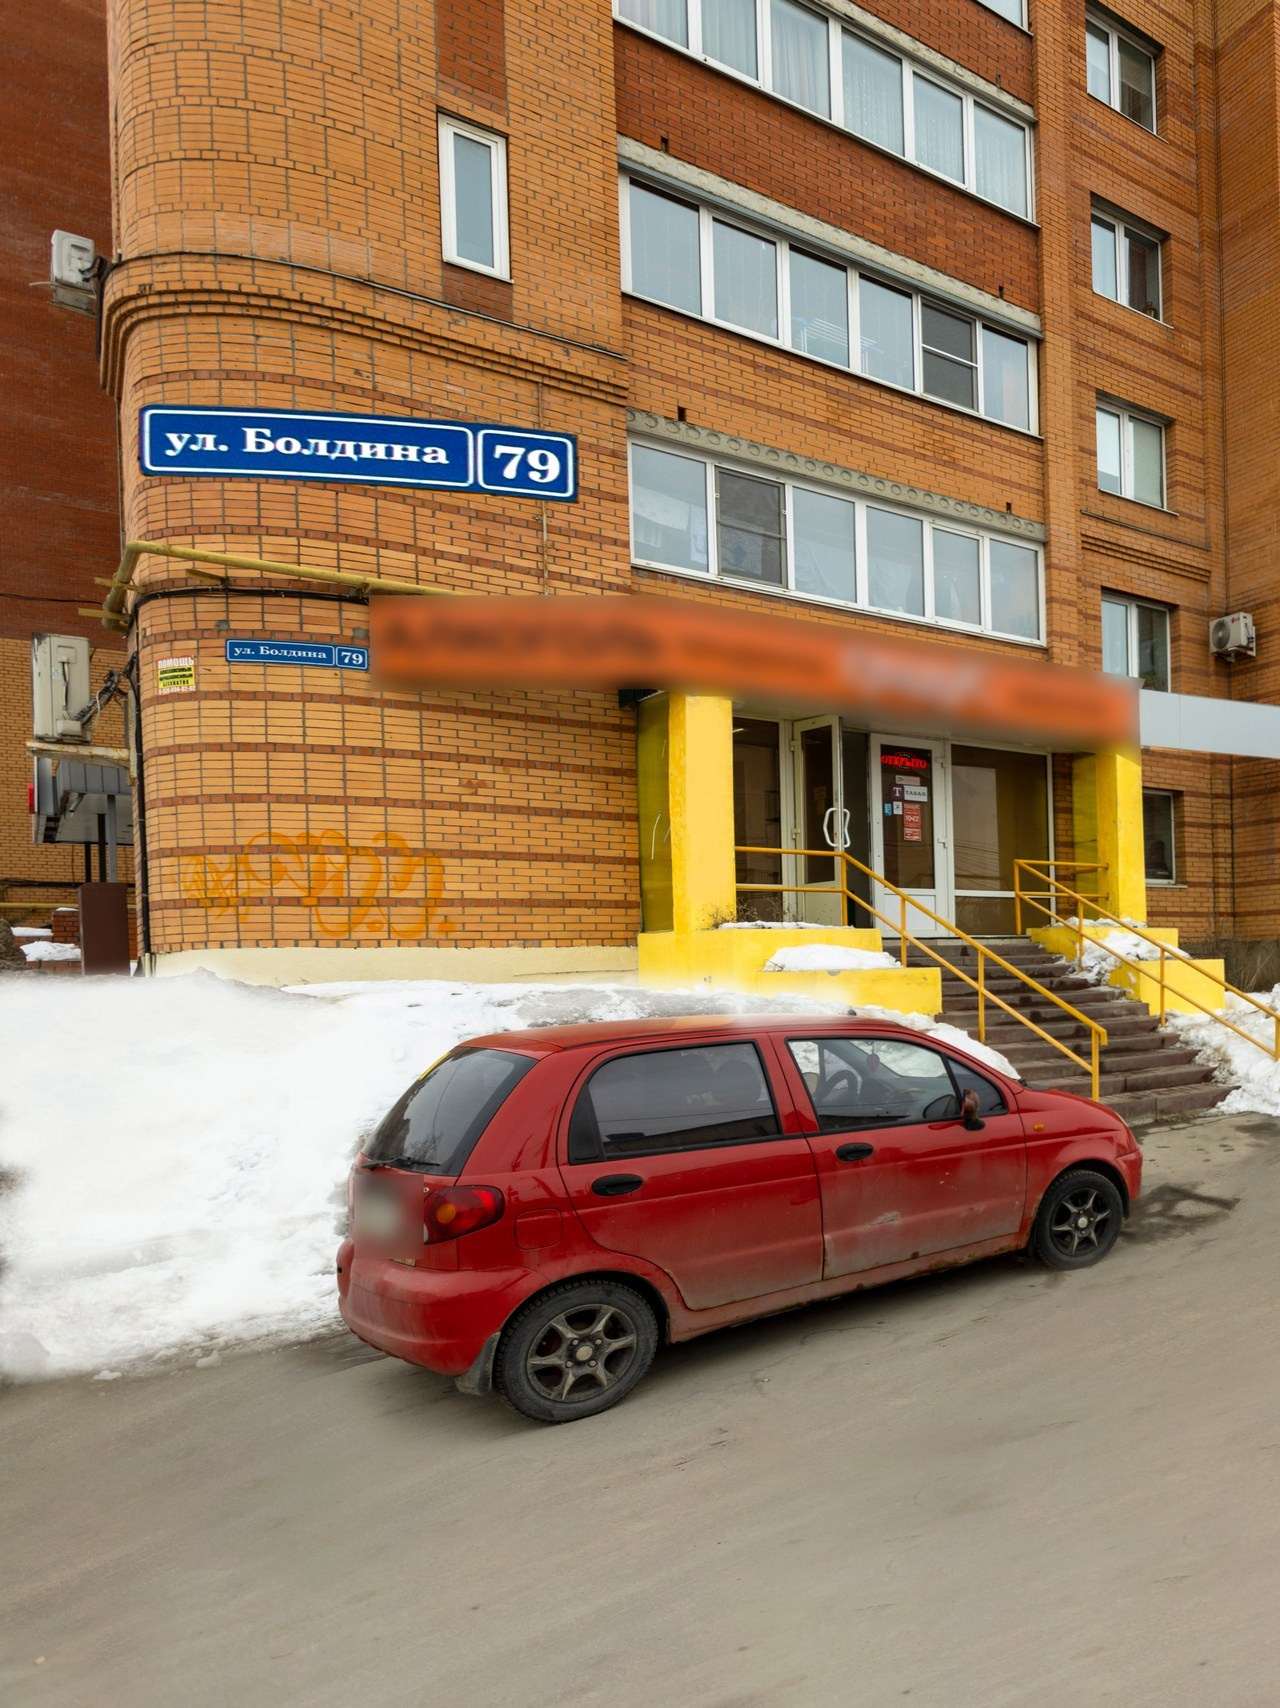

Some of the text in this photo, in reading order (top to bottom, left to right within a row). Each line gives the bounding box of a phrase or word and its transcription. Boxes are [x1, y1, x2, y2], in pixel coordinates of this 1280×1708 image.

[166, 428, 560, 483] ул. Болдина 79
[233, 645, 363, 665] ул. Болдина 79
[881, 756, 927, 769] ОТКРЫТО
